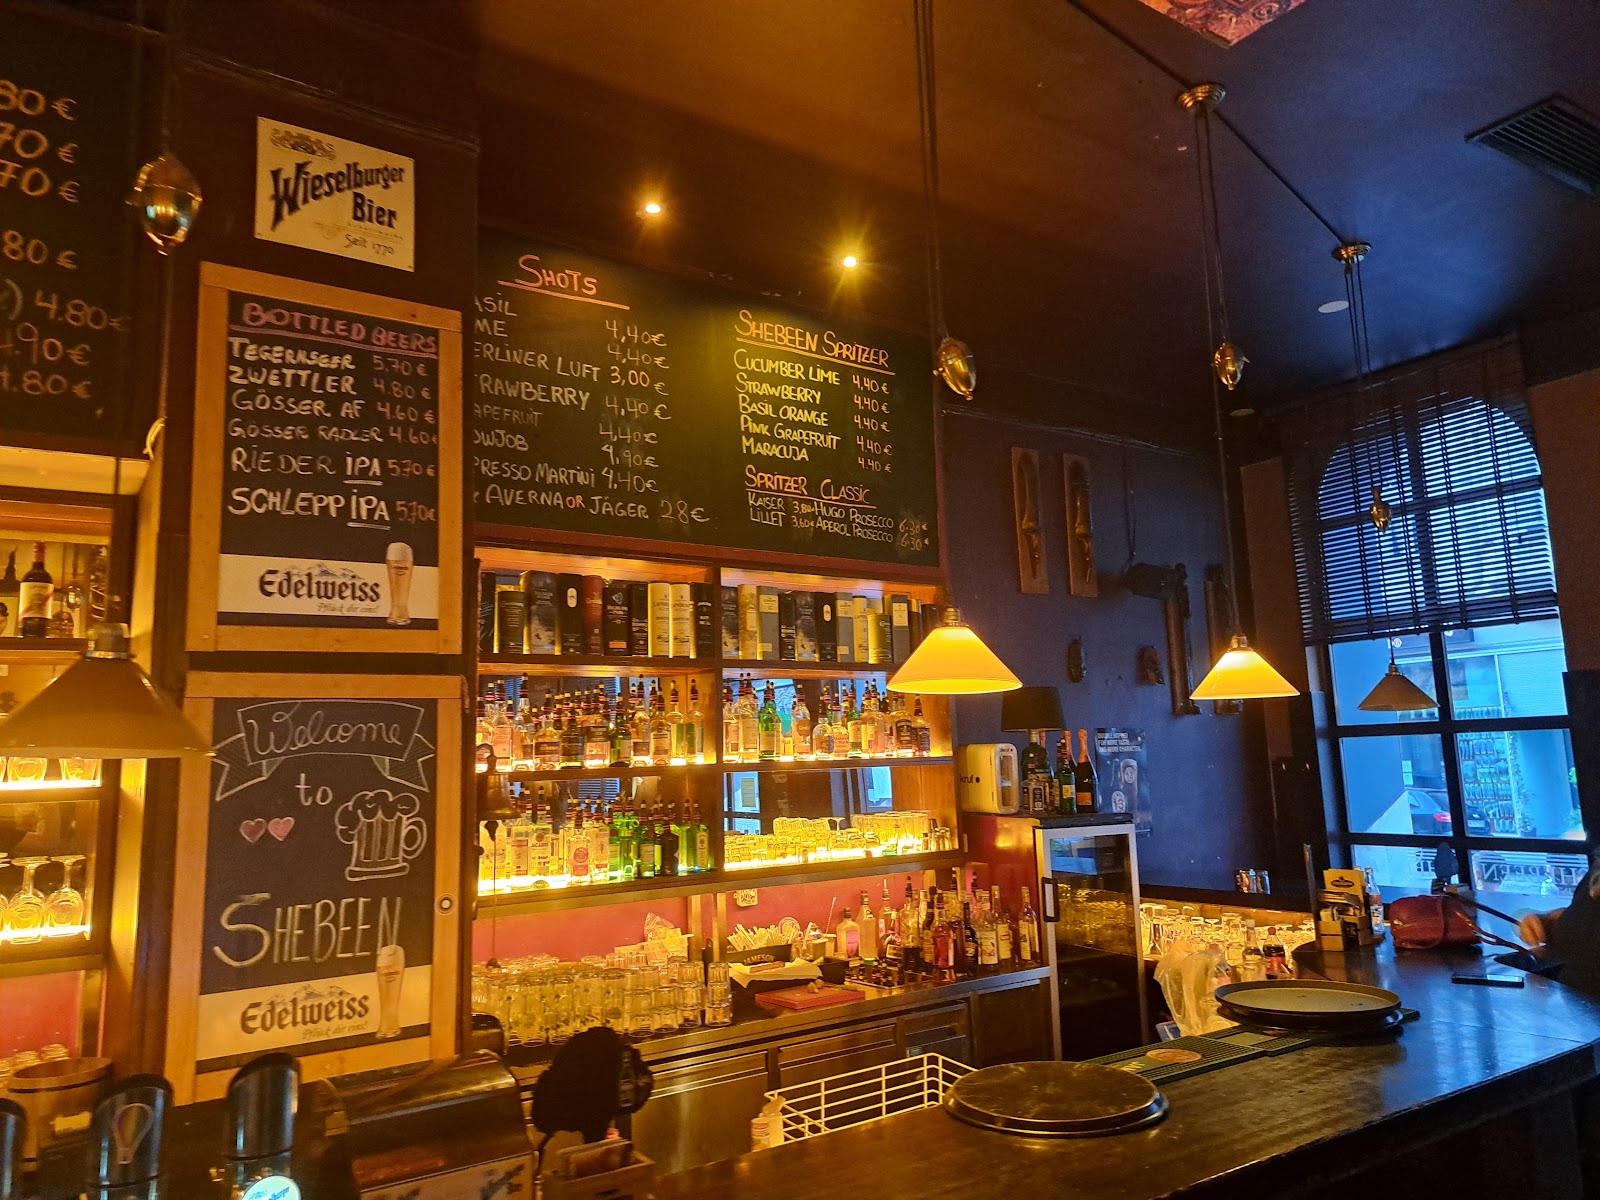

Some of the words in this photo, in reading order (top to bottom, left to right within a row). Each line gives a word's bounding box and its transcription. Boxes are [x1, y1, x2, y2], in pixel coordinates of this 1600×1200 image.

[269, 160, 405, 232] Wieselburger
[352, 190, 397, 228] Bier
[515, 254, 598, 296] SHOTS
[242, 302, 367, 341] BOTTLED
[371, 326, 437, 353] BEERS
[735, 309, 819, 352] SHEBEEN
[228, 365, 357, 396] ZWETTLER
[557, 356, 601, 382] LUFT
[733, 348, 806, 381] CUCUMBER
[232, 387, 332, 418] GÖSSER
[340, 399, 365, 420] AF
[474, 373, 590, 411] RAWBERRY
[735, 371, 821, 405] STRAWBERRY
[779, 404, 829, 427] ORANGE
[741, 435, 809, 462] MARACUJA
[227, 486, 346, 518] SCHLEPP
[485, 484, 564, 510] AVERNA
[565, 494, 586, 509] OR
[589, 495, 650, 520] JÄGER
[814, 500, 846, 519] HUGO
[849, 508, 894, 529] PROSECCO
[815, 516, 851, 537] APEROL
[852, 523, 894, 543] PROSECCO
[258, 568, 381, 603] Edelweiss
[246, 701, 403, 755] Welcome
[295, 773, 333, 806] to
[213, 892, 402, 968] SHEBEEN
[240, 994, 370, 1035] Edelweiss
